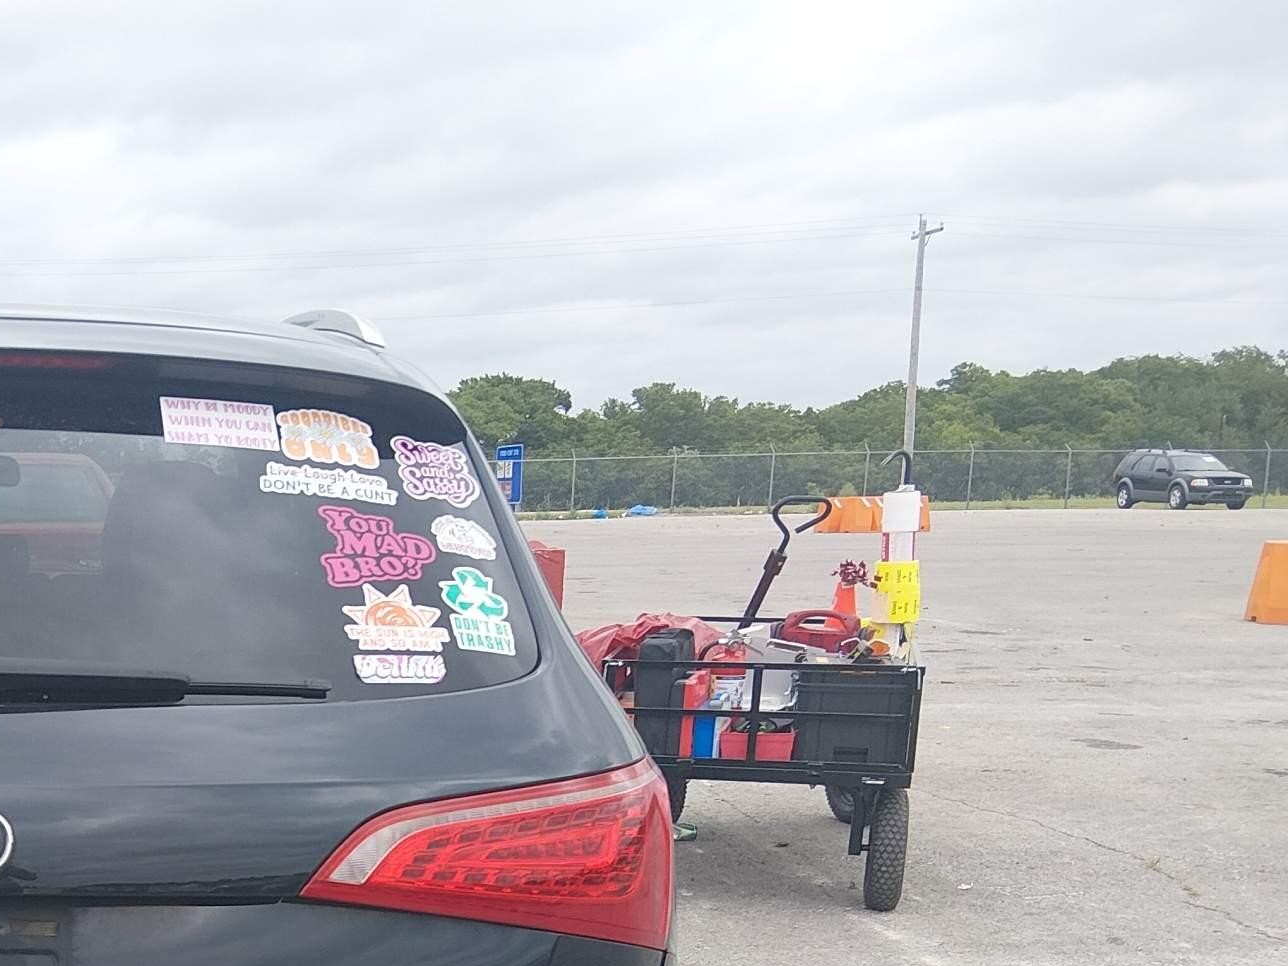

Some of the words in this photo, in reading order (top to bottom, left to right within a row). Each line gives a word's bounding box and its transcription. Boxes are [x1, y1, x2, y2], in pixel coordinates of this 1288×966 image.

[165, 399, 200, 410] WHY
[224, 403, 269, 416] MOODY
[215, 417, 242, 430] YOU
[246, 420, 273, 432] CAN
[394, 439, 462, 470] Sweet
[270, 465, 298, 476] Live
[304, 468, 344, 484] Laugh
[352, 473, 383, 486] Love
[421, 463, 454, 479] and
[264, 479, 311, 491] DON'T
[318, 484, 335, 494] BE
[341, 486, 350, 497] A
[355, 488, 393, 502] CUNT
[404, 467, 473, 503] Sassy
[323, 509, 389, 535] YOU
[338, 530, 432, 560] MAD
[325, 557, 417, 582] BRO?
[350, 628, 371, 638] THE
[376, 628, 400, 638] SUN
[403, 629, 414, 639] IS
[454, 617, 489, 632] DON'T
[495, 623, 510, 636] BE
[362, 639, 385, 648] AND
[392, 640, 406, 648] SO
[412, 640, 430, 649] AM
[458, 632, 511, 652] TRASHY
